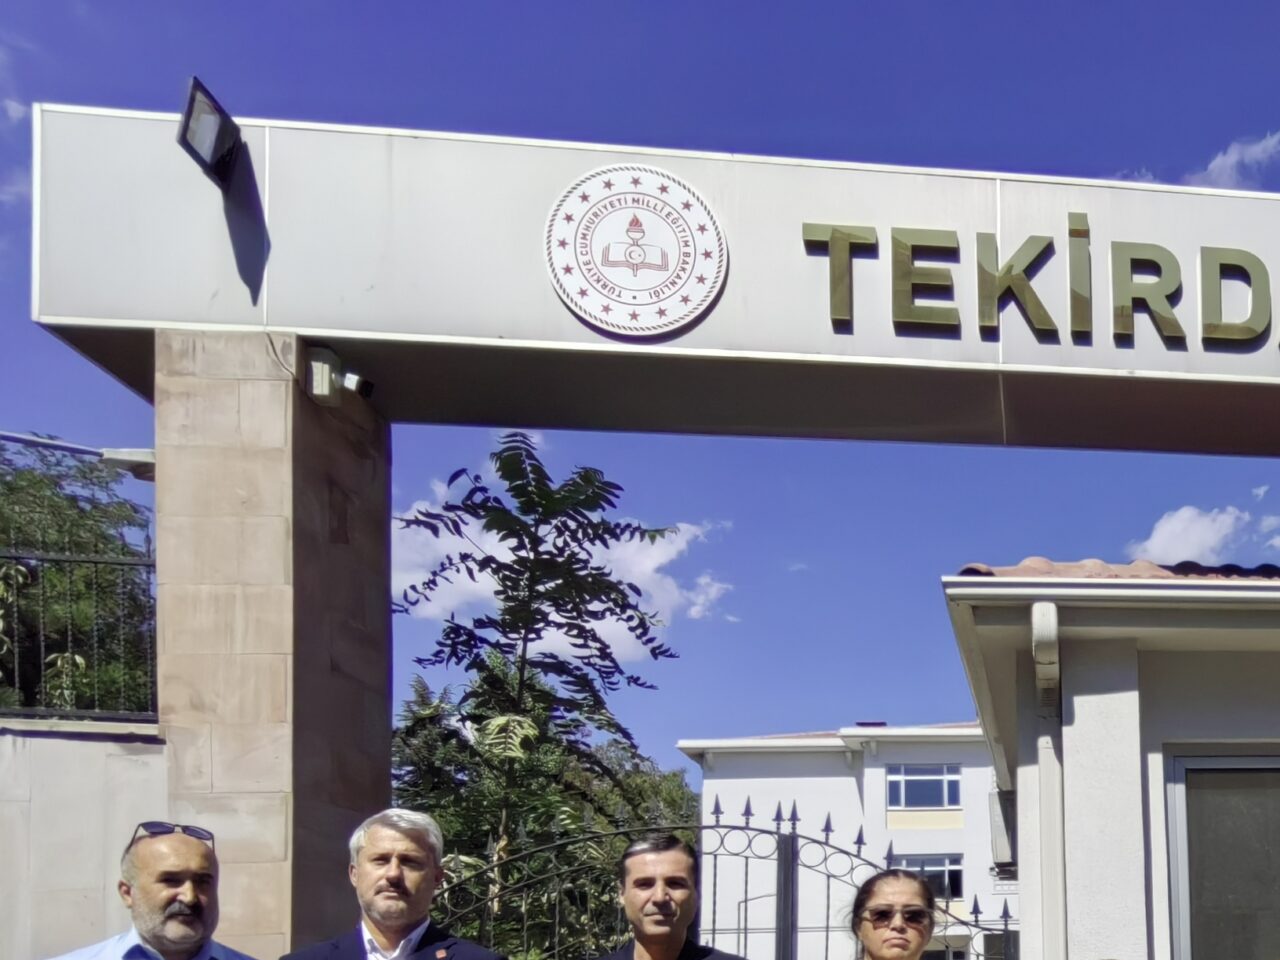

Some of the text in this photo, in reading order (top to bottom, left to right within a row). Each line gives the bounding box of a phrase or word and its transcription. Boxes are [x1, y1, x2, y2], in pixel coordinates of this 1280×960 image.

[580, 197, 691, 299] TÜRKİYE CUMHURİYETİ MİLLİ EĞİTİM BAKANLIĞI
